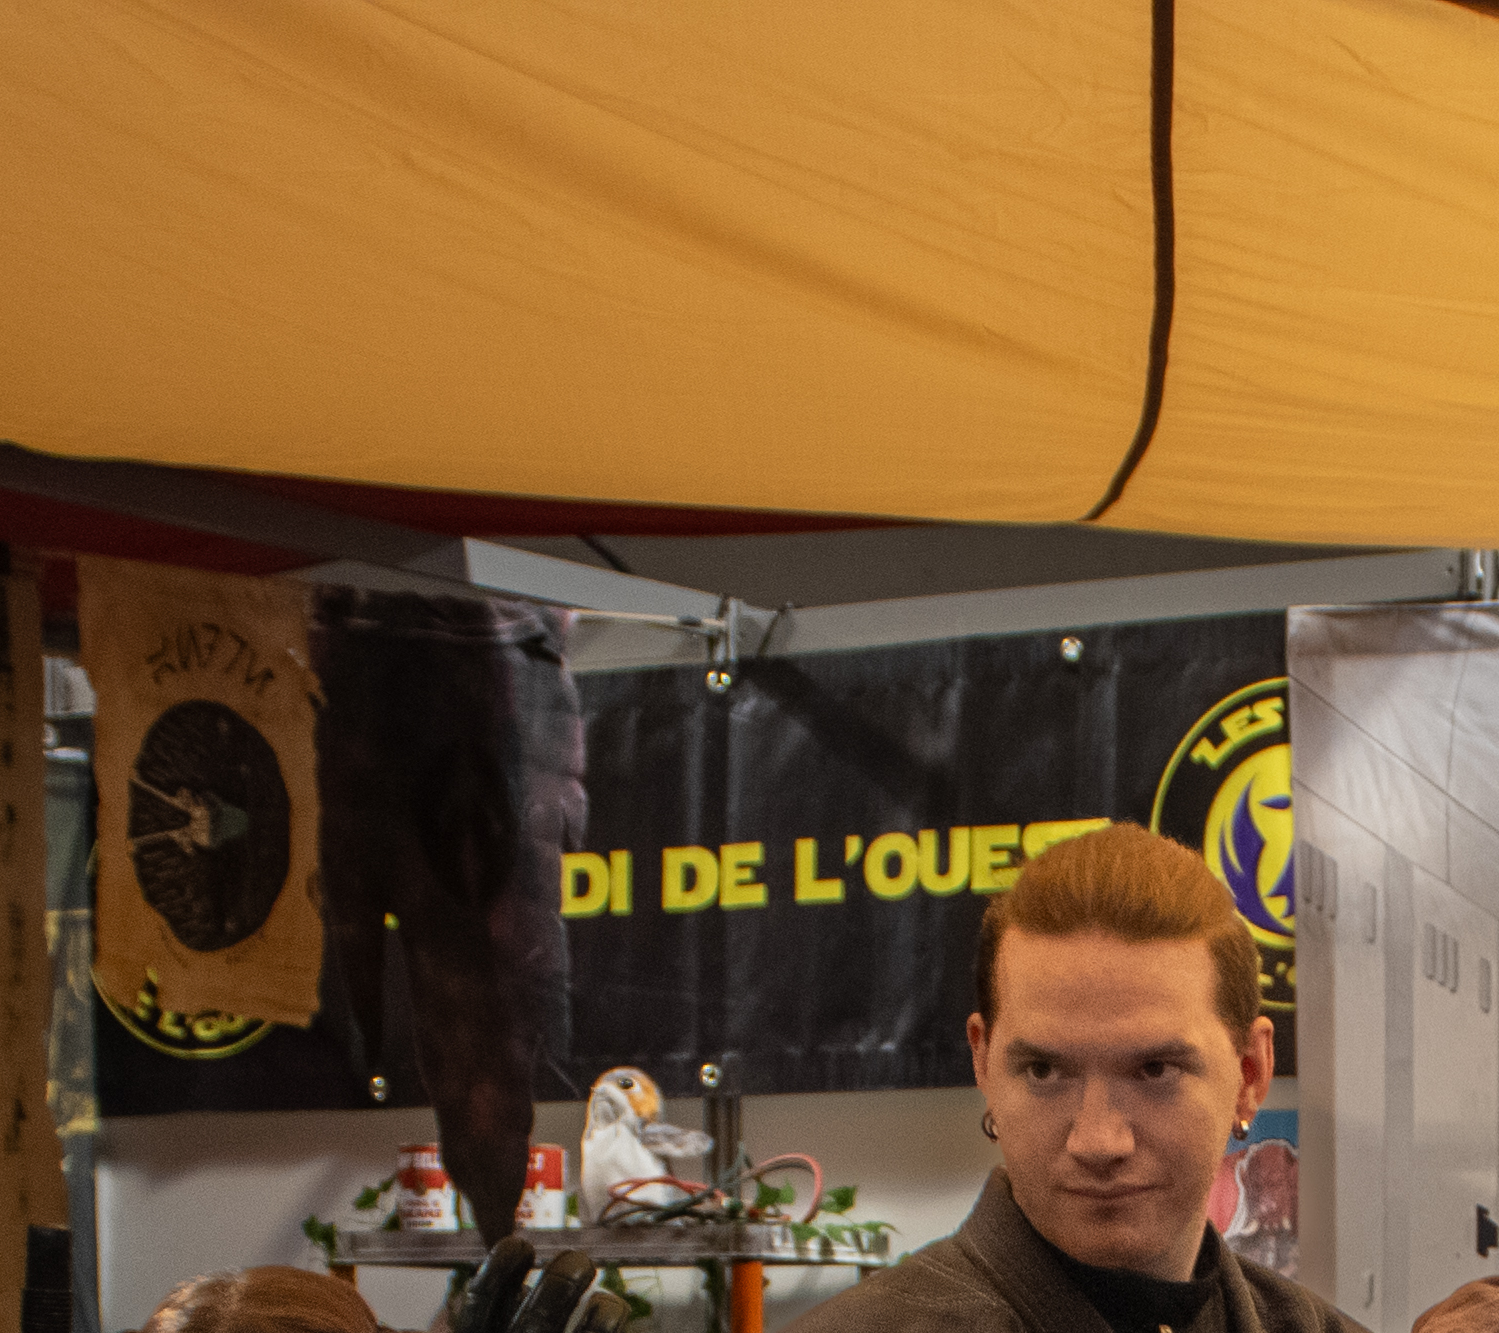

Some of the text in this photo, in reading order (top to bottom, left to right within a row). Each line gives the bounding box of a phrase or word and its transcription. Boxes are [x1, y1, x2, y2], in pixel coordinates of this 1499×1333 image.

[1189, 697, 1286, 771] LES
[559, 849, 634, 919] DI
[661, 840, 770, 914] DE
